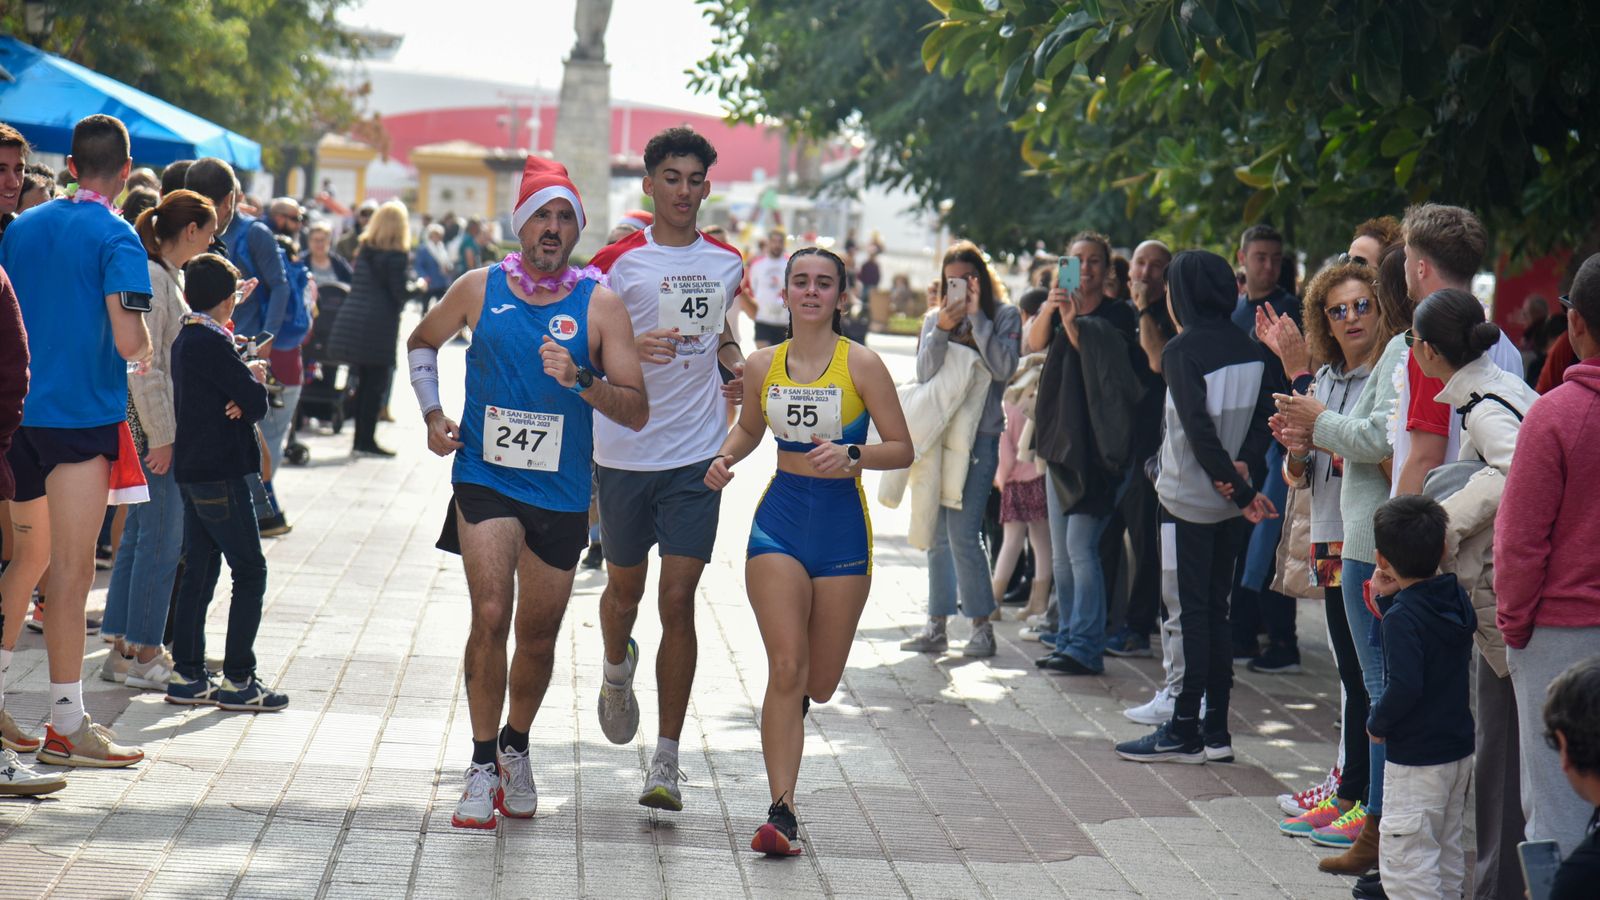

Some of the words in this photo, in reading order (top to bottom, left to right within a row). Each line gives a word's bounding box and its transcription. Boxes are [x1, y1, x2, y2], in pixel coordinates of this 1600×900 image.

[680, 297, 709, 319] 45
[509, 417, 535, 426] TARIFEÑA
[523, 412, 560, 422] SILVESTRE
[787, 404, 818, 427] 55
[496, 426, 548, 452] 247
